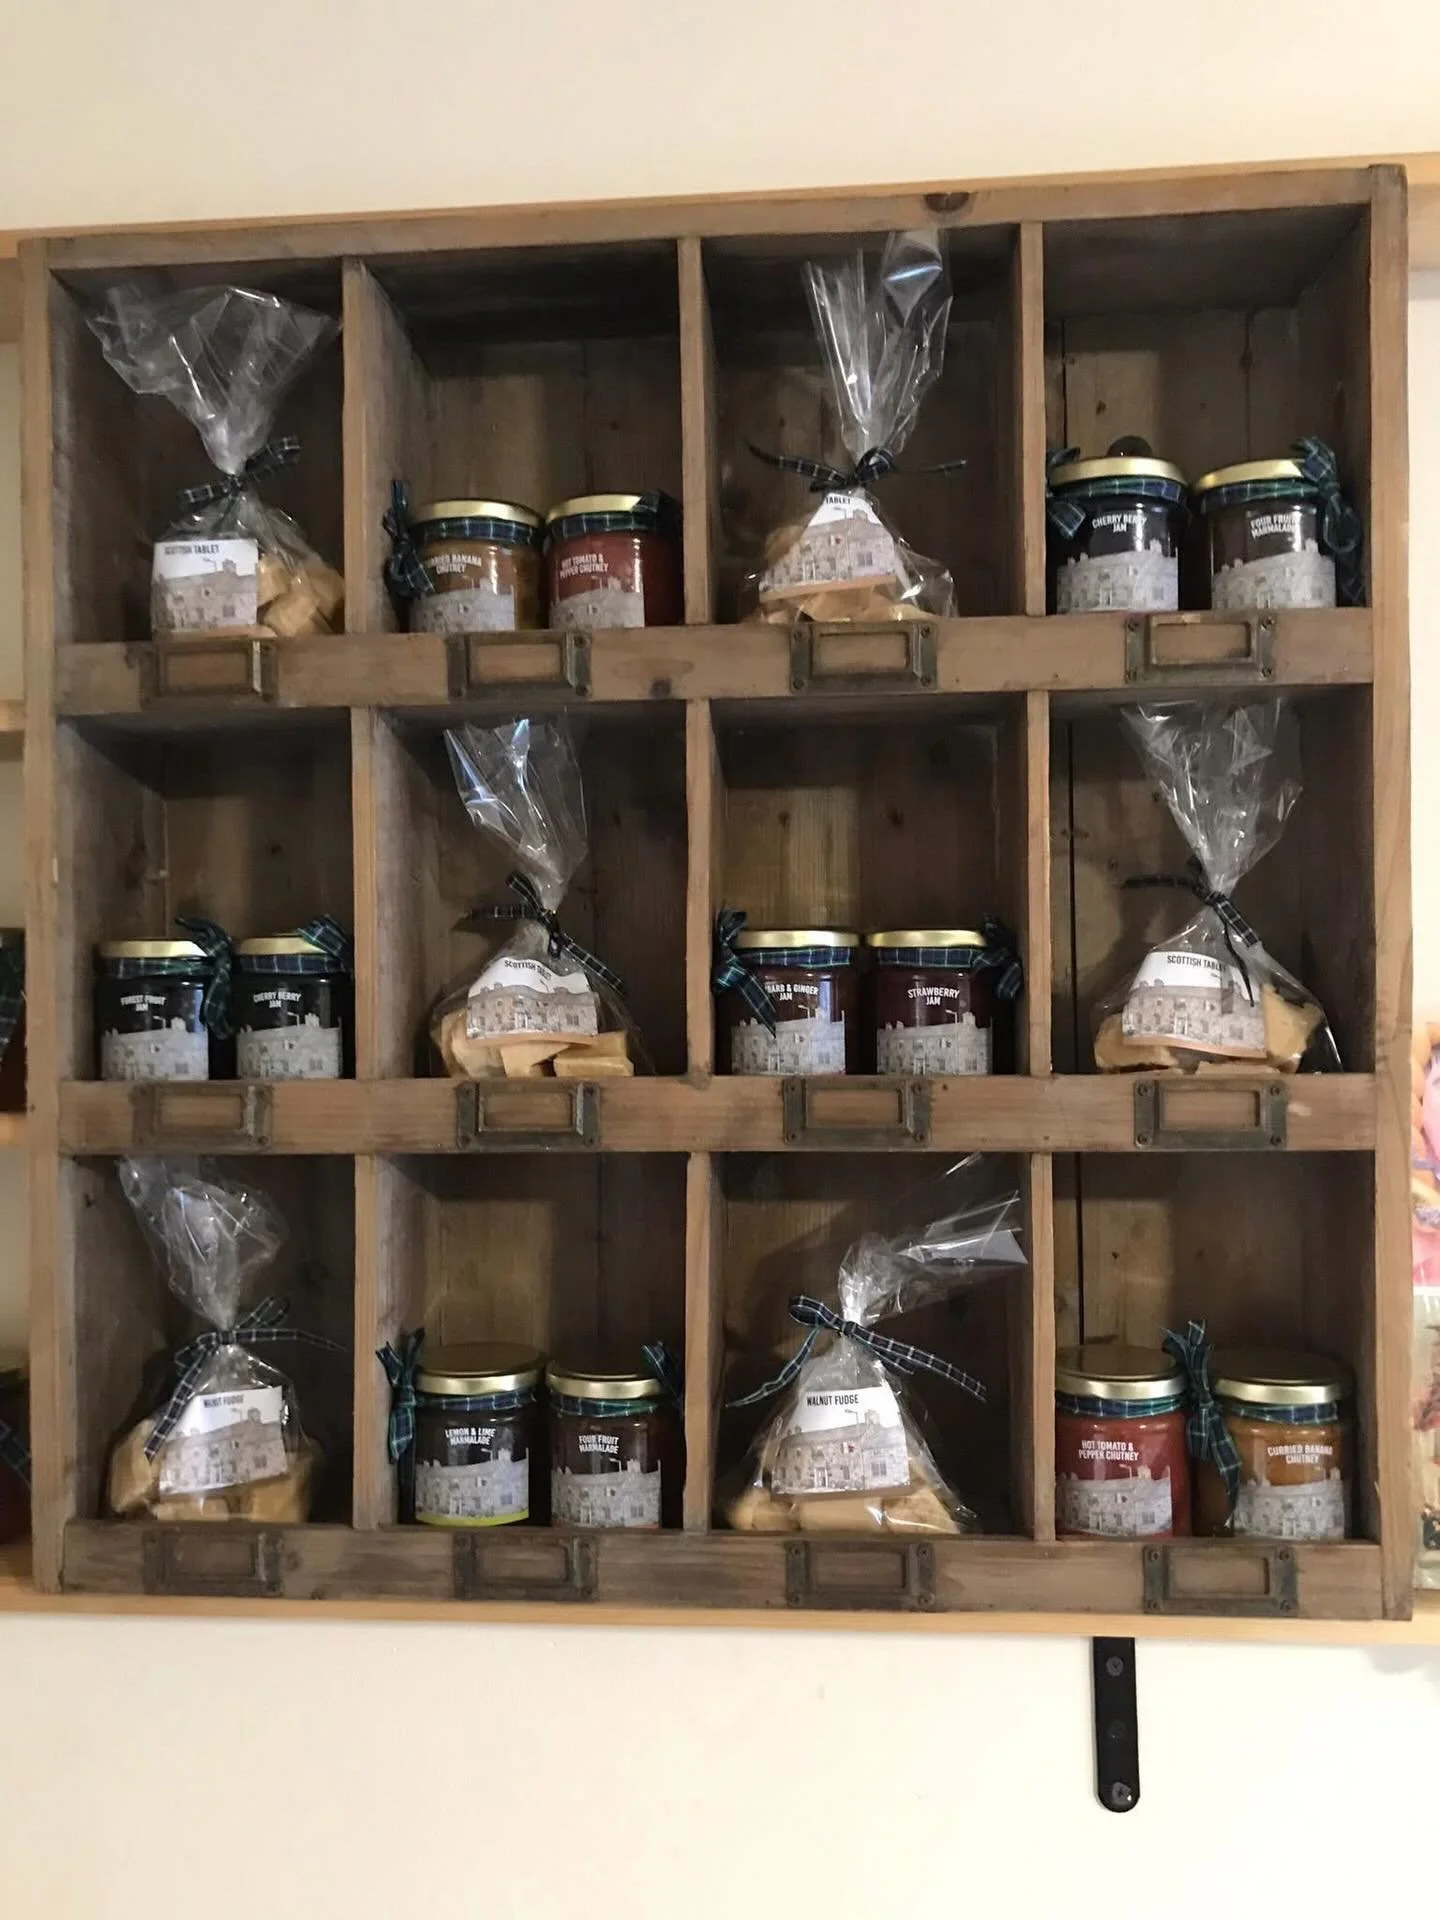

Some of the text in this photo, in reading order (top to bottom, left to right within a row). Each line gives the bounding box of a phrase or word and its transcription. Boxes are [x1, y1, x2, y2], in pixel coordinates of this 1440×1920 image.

[1092, 514, 1122, 528] CHERRY
[1251, 515, 1272, 530] FOUR
[1113, 523, 1127, 532] JAM
[194, 544, 219, 554] TABLET
[451, 553, 482, 567] BANANA
[579, 563, 609, 573] CHUTNEY
[1167, 955, 1202, 966] SCOTTISH
[786, 983, 792, 992] &
[793, 984, 819, 995] GINGER
[907, 987, 960, 999] STRAWBERRY
[277, 991, 301, 1001] BERRY
[779, 992, 793, 1000] JAM
[926, 997, 941, 1006] JAM
[806, 1394, 859, 1406] WALNUT FUDGE
[445, 1427, 496, 1438] LEMON & LIME
[449, 1436, 491, 1446] MARMALADE
[579, 1435, 619, 1445] FOUR FRUIT
[1082, 1440, 1134, 1451] HOT TOMATO &
[579, 1444, 619, 1454] MARMALADE
[1267, 1445, 1334, 1457] CURRIED BANANA
[1079, 1449, 1139, 1461] PEPPER CHUTNEY
[1285, 1454, 1319, 1465] CHUTNEY
